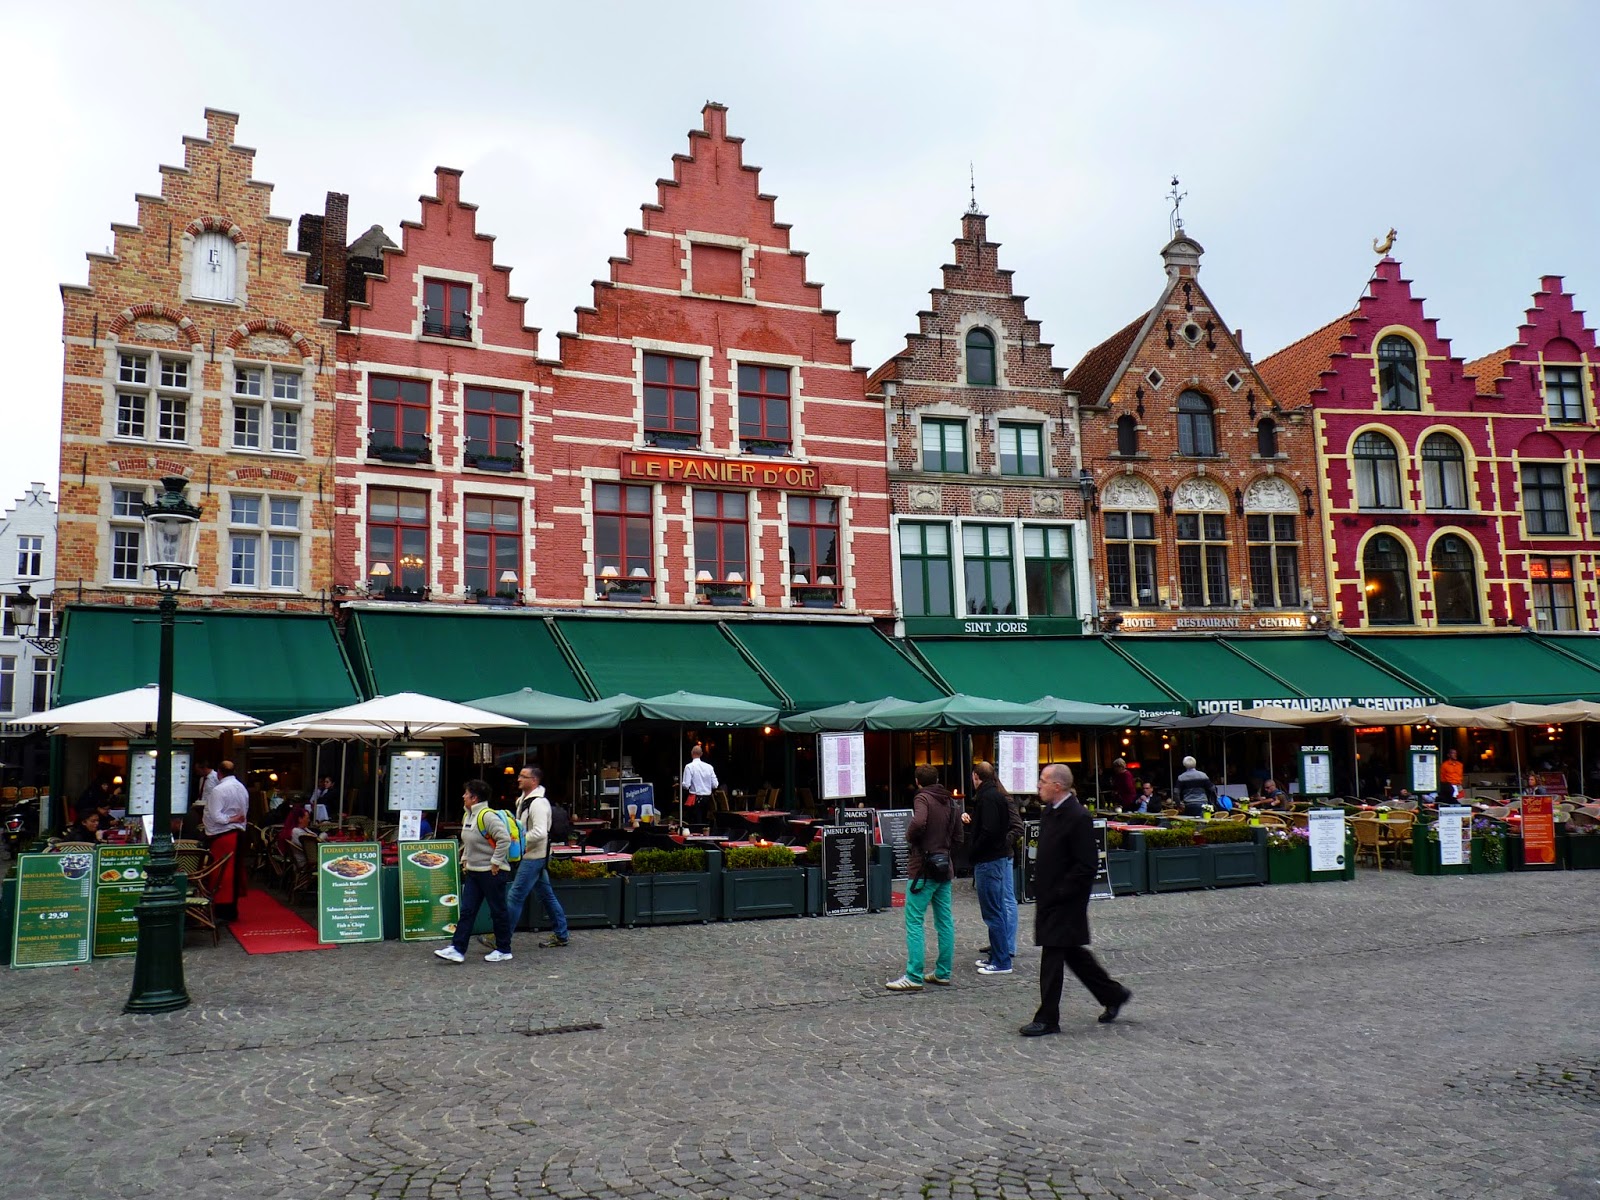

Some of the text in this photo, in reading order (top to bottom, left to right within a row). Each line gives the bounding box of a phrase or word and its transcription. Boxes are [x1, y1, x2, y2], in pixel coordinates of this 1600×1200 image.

[630, 458, 815, 487] LE PANIER D'OR
[964, 622, 1028, 633] SINT JORIS
[1124, 618, 1302, 628] HOTEL RESTAURANT CENTRAL
[1198, 700, 1244, 715] HOTEL
